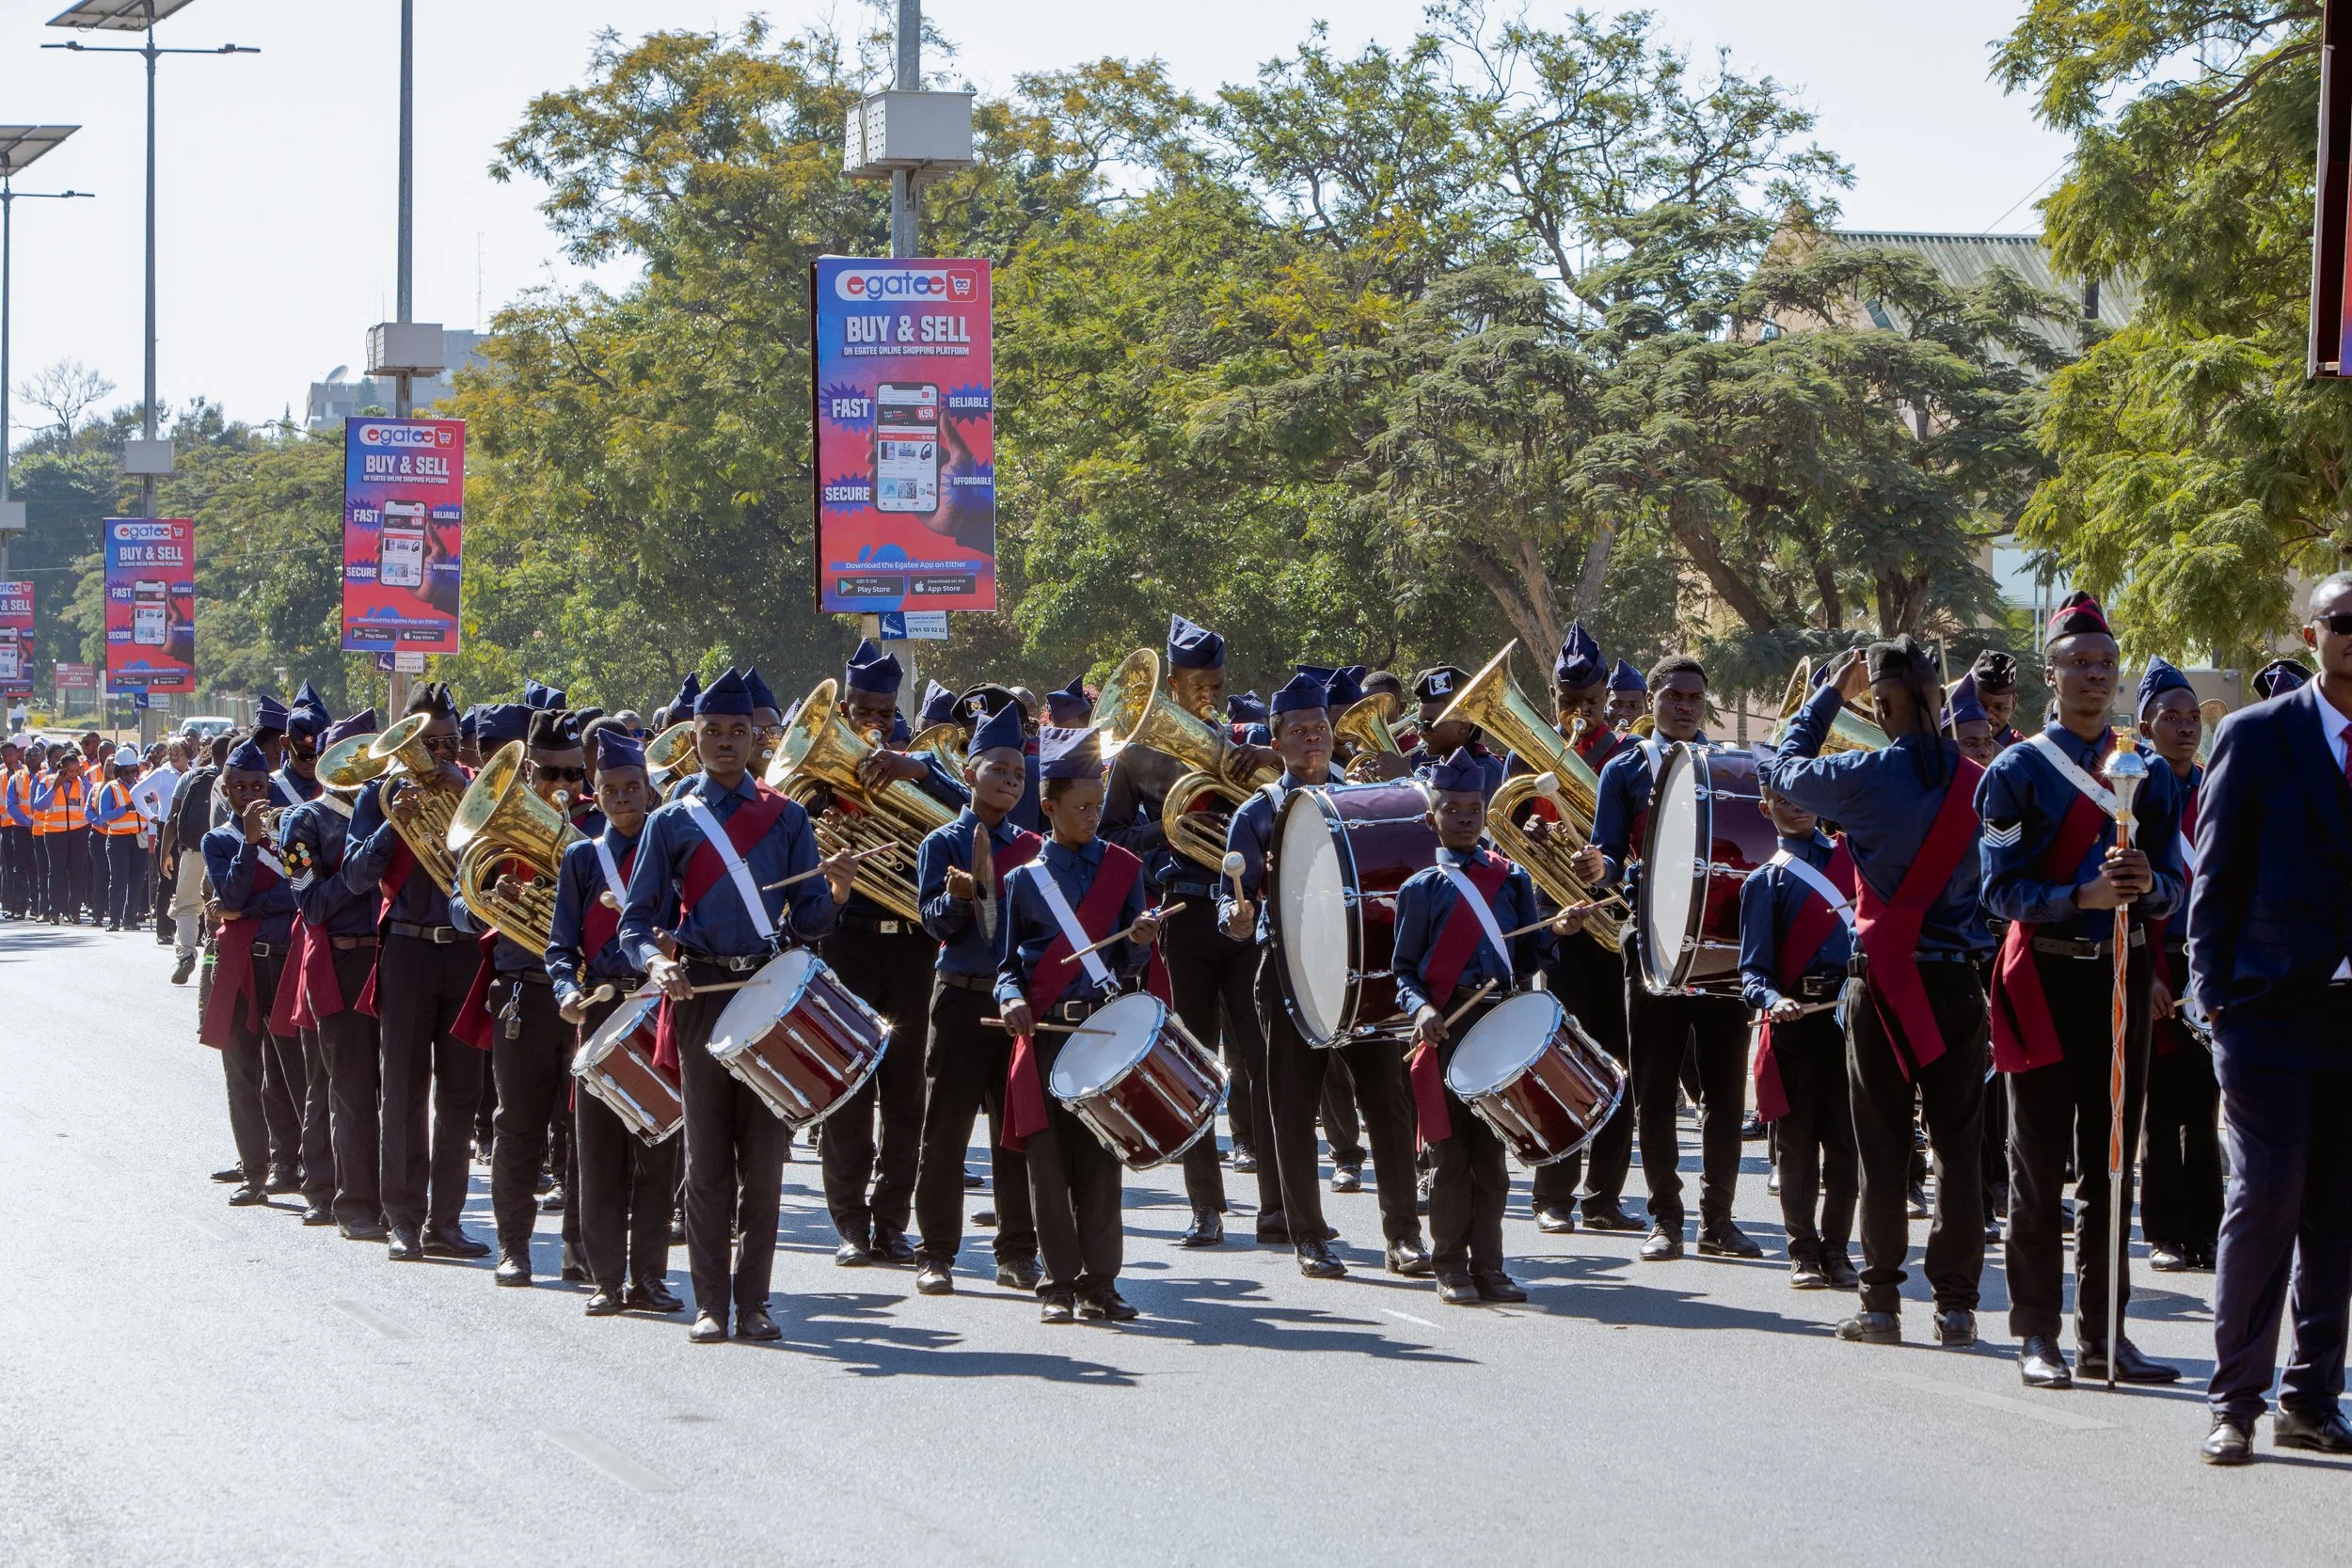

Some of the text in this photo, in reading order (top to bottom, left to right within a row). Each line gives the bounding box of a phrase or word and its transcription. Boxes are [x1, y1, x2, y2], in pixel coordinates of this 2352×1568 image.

[847, 271, 946, 300] egatee
[847, 315, 971, 342] BUY & SELL
[844, 346, 969, 356] ON EGATEE ONLINE SHOPPING PLATFORM
[832, 398, 870, 418] FAST
[949, 397, 989, 407] RELIABLE
[918, 408, 934, 419] K50
[367, 427, 434, 445] egatee
[365, 454, 449, 476] BUY & SELL
[953, 477, 993, 485] AFFORDABLE
[825, 486, 870, 501] SECURE
[353, 509, 379, 523] FAST
[433, 511, 460, 520] RELIABLE
[120, 525, 169, 539] egatee
[119, 546, 183, 561] BUY & SELL
[346, 566, 376, 578] SECURE
[895, 562, 919, 570] Egatee
[920, 562, 934, 570] App
[112, 587, 132, 598] FAST
[10, 599, 31, 610] SELL
[108, 631, 132, 640] SECURE
